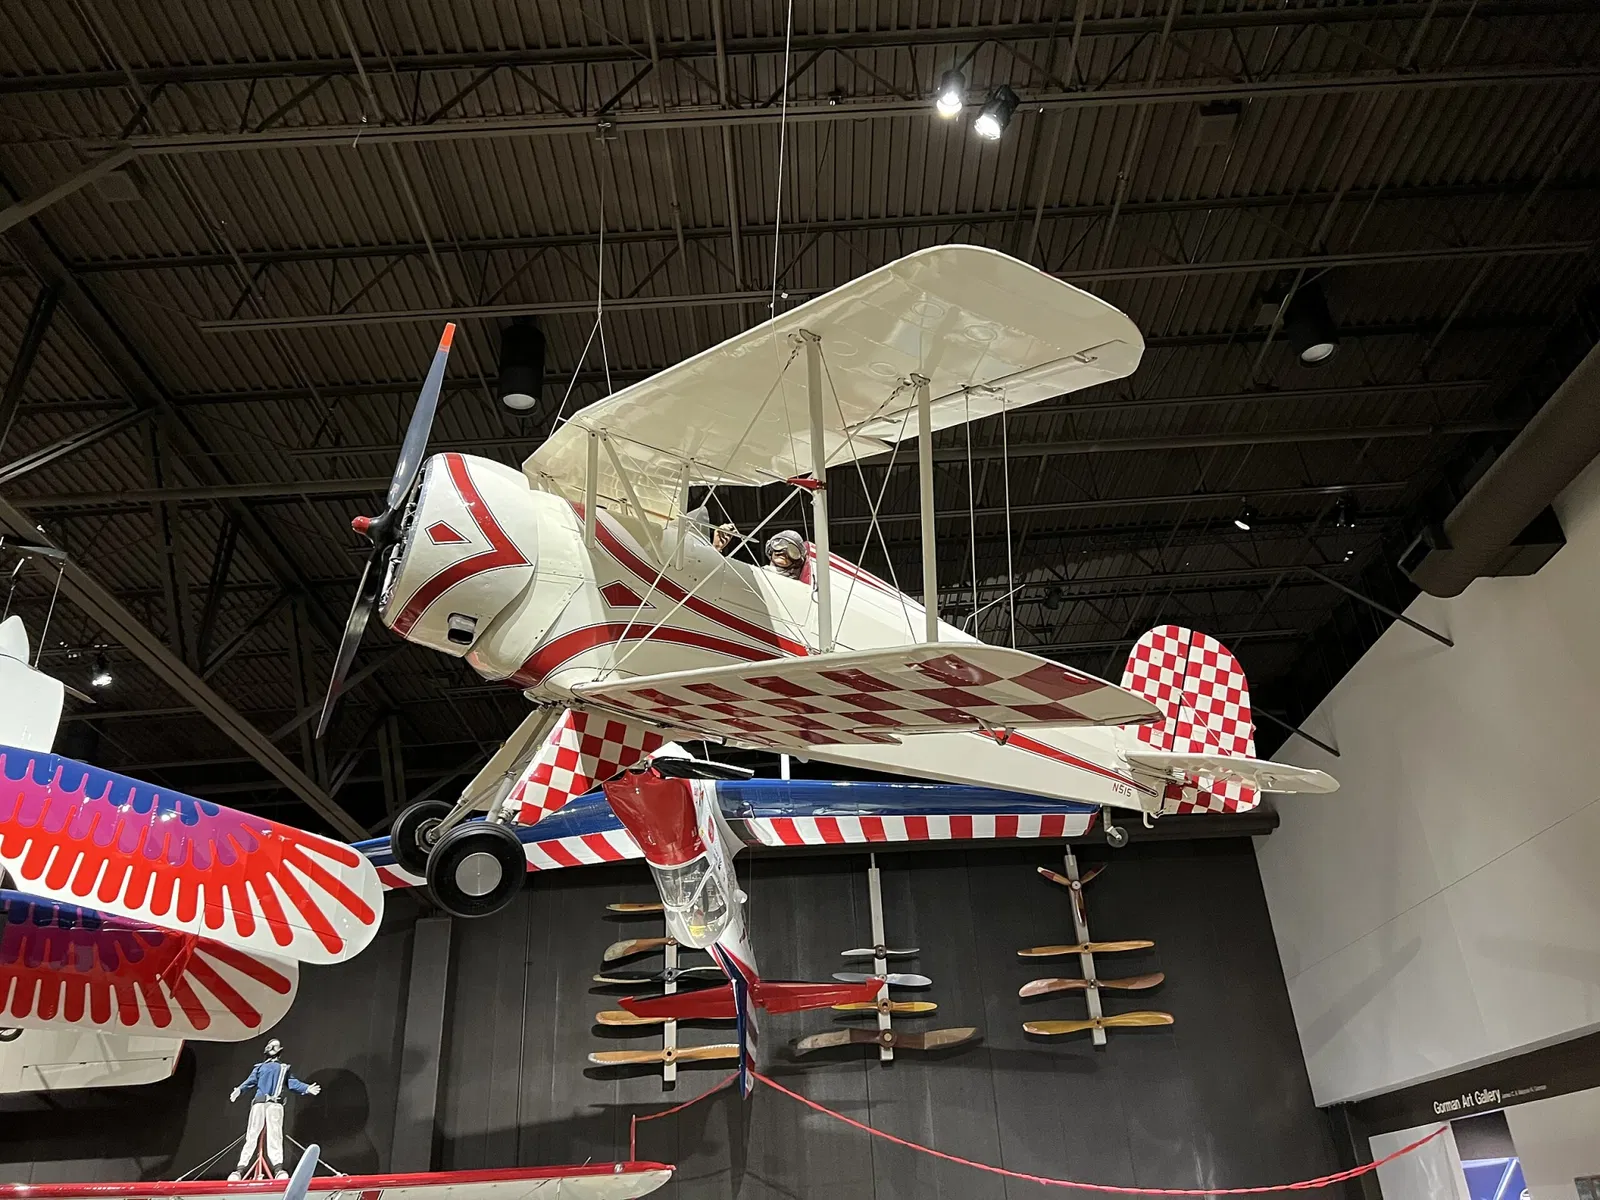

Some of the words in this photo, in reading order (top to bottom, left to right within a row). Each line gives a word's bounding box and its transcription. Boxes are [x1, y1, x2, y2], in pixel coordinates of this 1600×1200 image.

[1112, 783, 1132, 797] N515
[1433, 1100, 1461, 1114] Gorman
[1461, 1094, 1474, 1108] Art
[1475, 1088, 1500, 1105] Gallery
